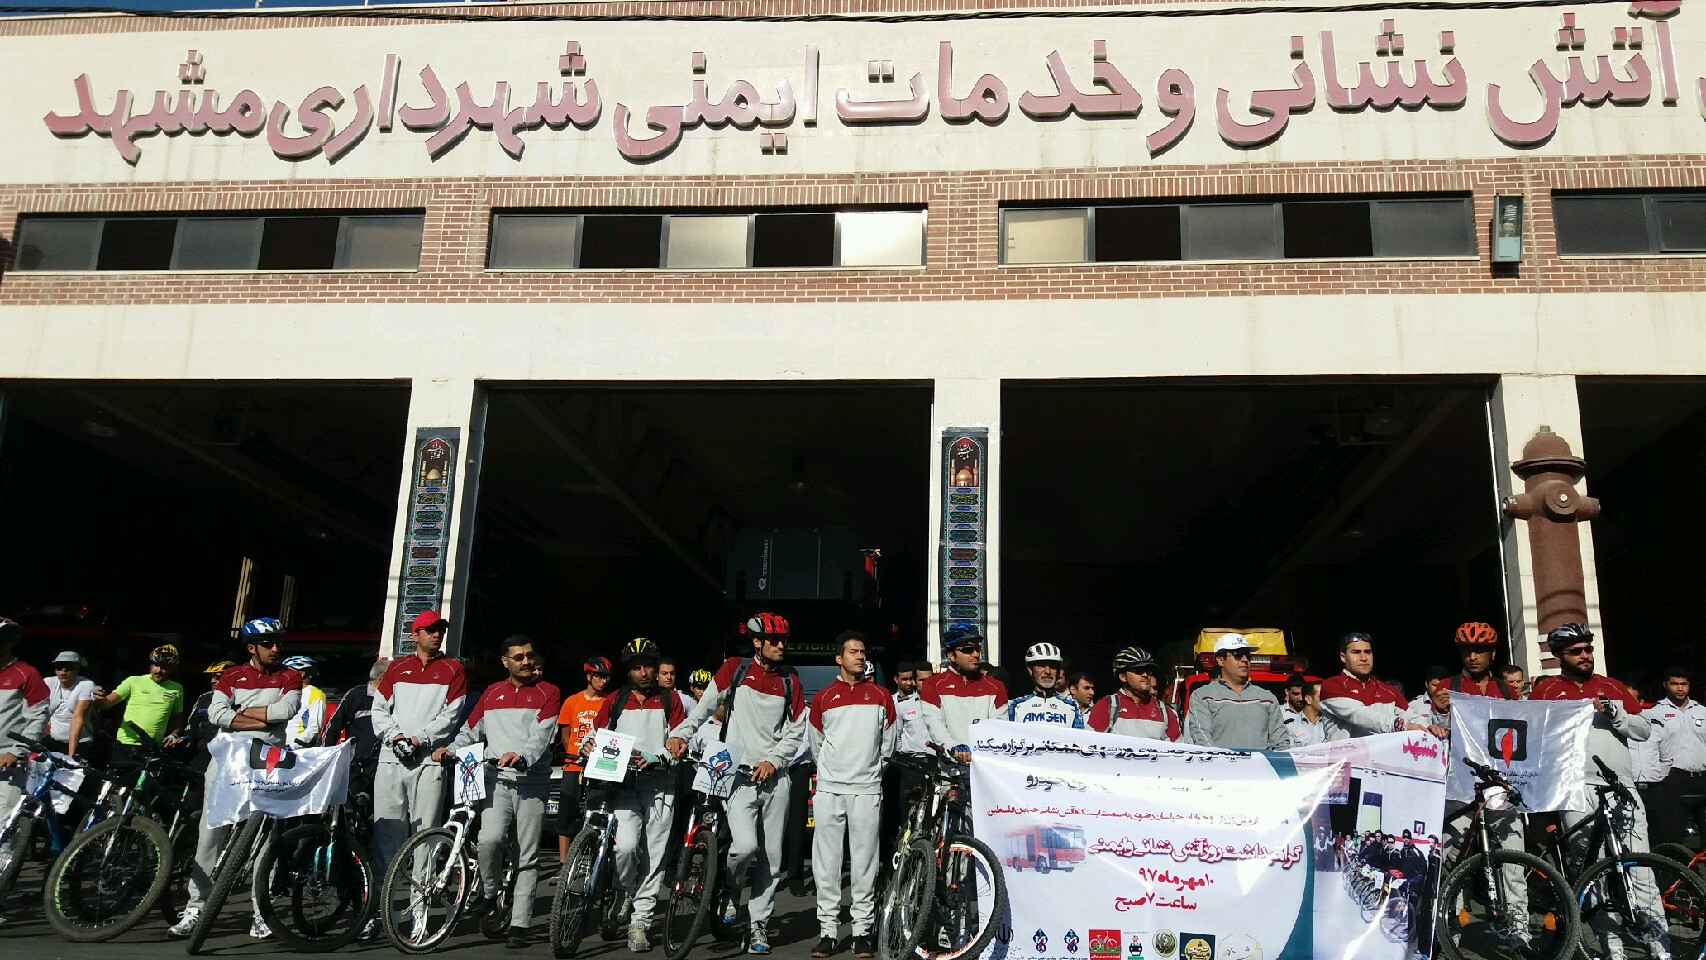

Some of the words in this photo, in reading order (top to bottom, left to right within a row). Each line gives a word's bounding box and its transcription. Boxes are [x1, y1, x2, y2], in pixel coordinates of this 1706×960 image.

[43, 48, 267, 166] مشهد
[267, 40, 605, 161] شهرداری
[613, 44, 822, 162] ایمنی
[1215, 19, 1470, 149] نشانی
[1487, 0, 1682, 149] آتش
[987, 804, 1015, 817] فلسطین
[1114, 895, 1148, 912] صبح
[1138, 866, 1158, 883] ۹۷
[1155, 895, 1198, 911] ساعت
